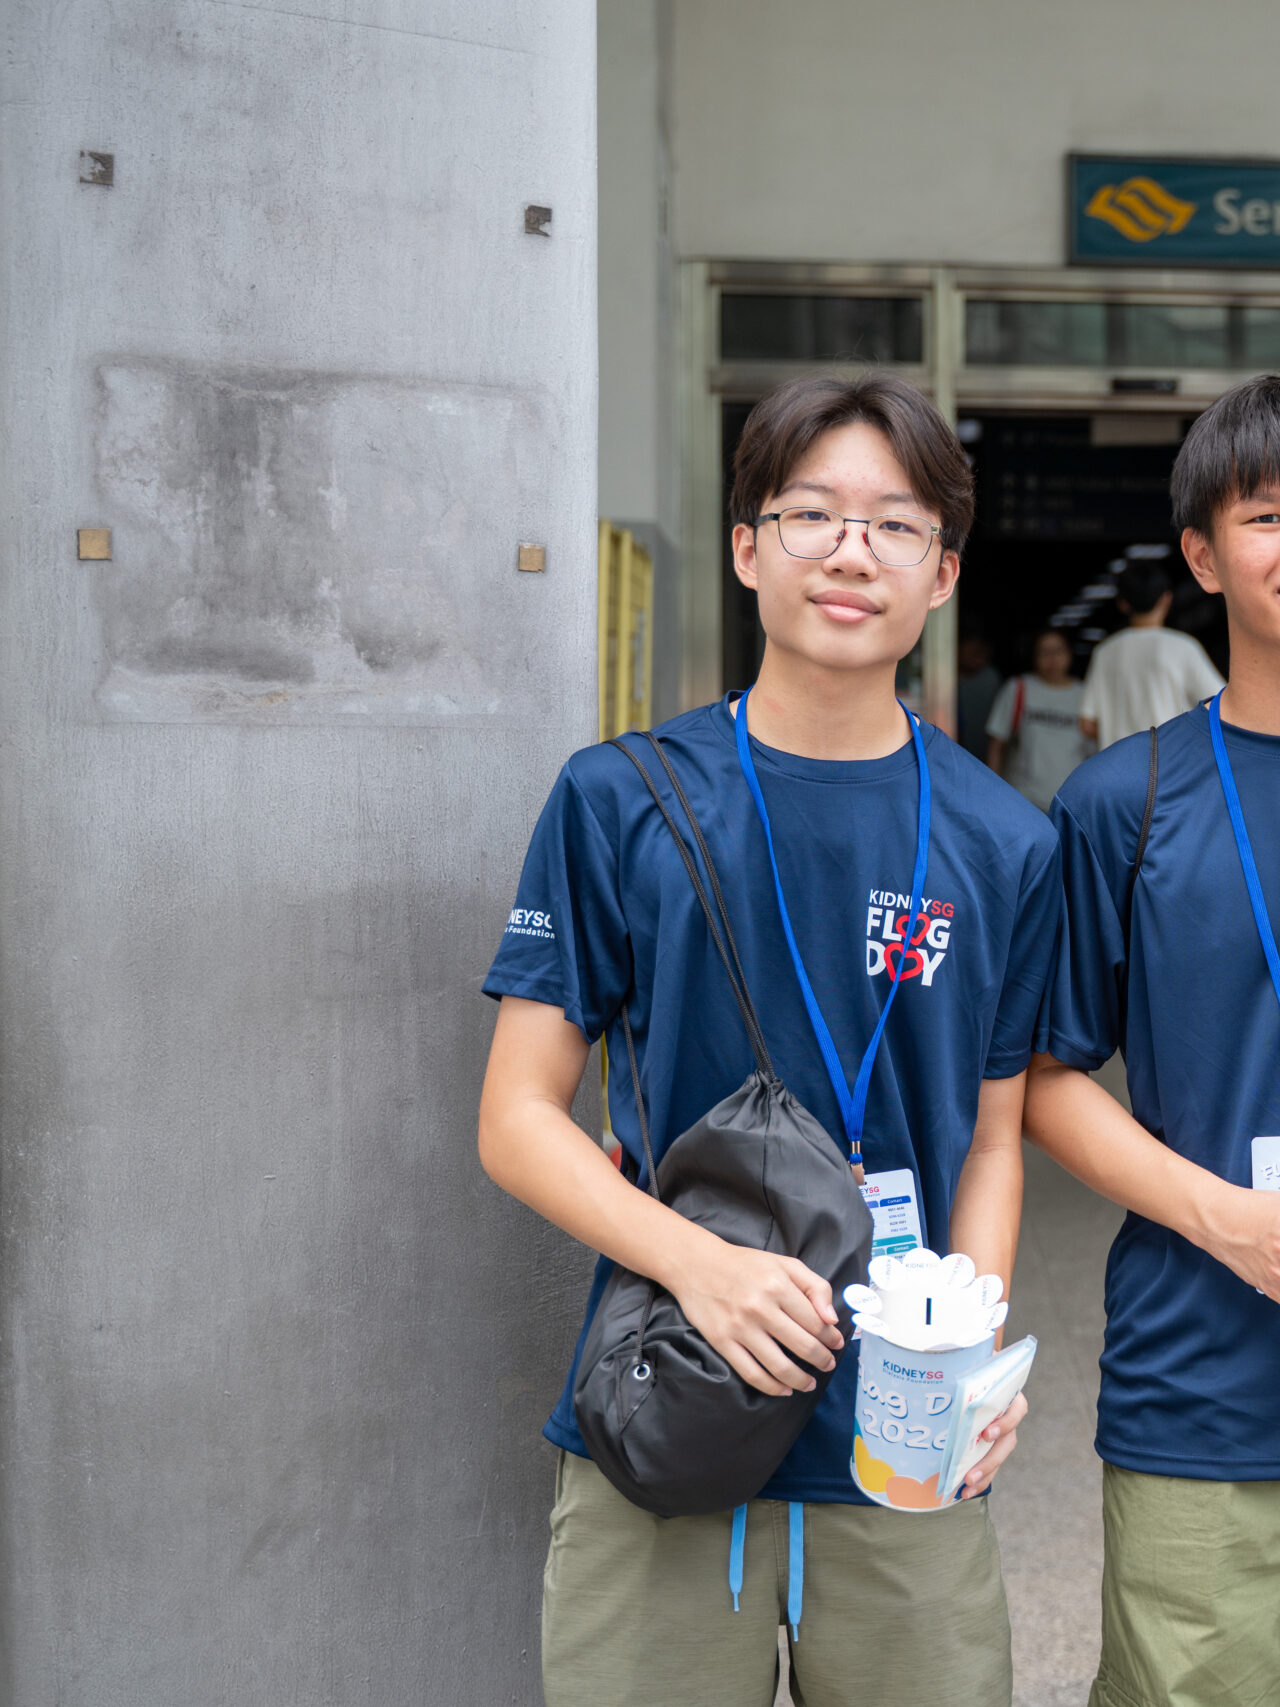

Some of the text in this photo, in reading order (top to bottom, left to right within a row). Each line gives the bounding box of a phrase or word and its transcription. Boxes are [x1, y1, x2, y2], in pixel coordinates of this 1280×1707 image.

[869, 888, 954, 917] KIDNYSG
[508, 908, 553, 929] NEYS
[509, 925, 556, 939] Foundation
[882, 1359, 944, 1380] KIDNEYSG
